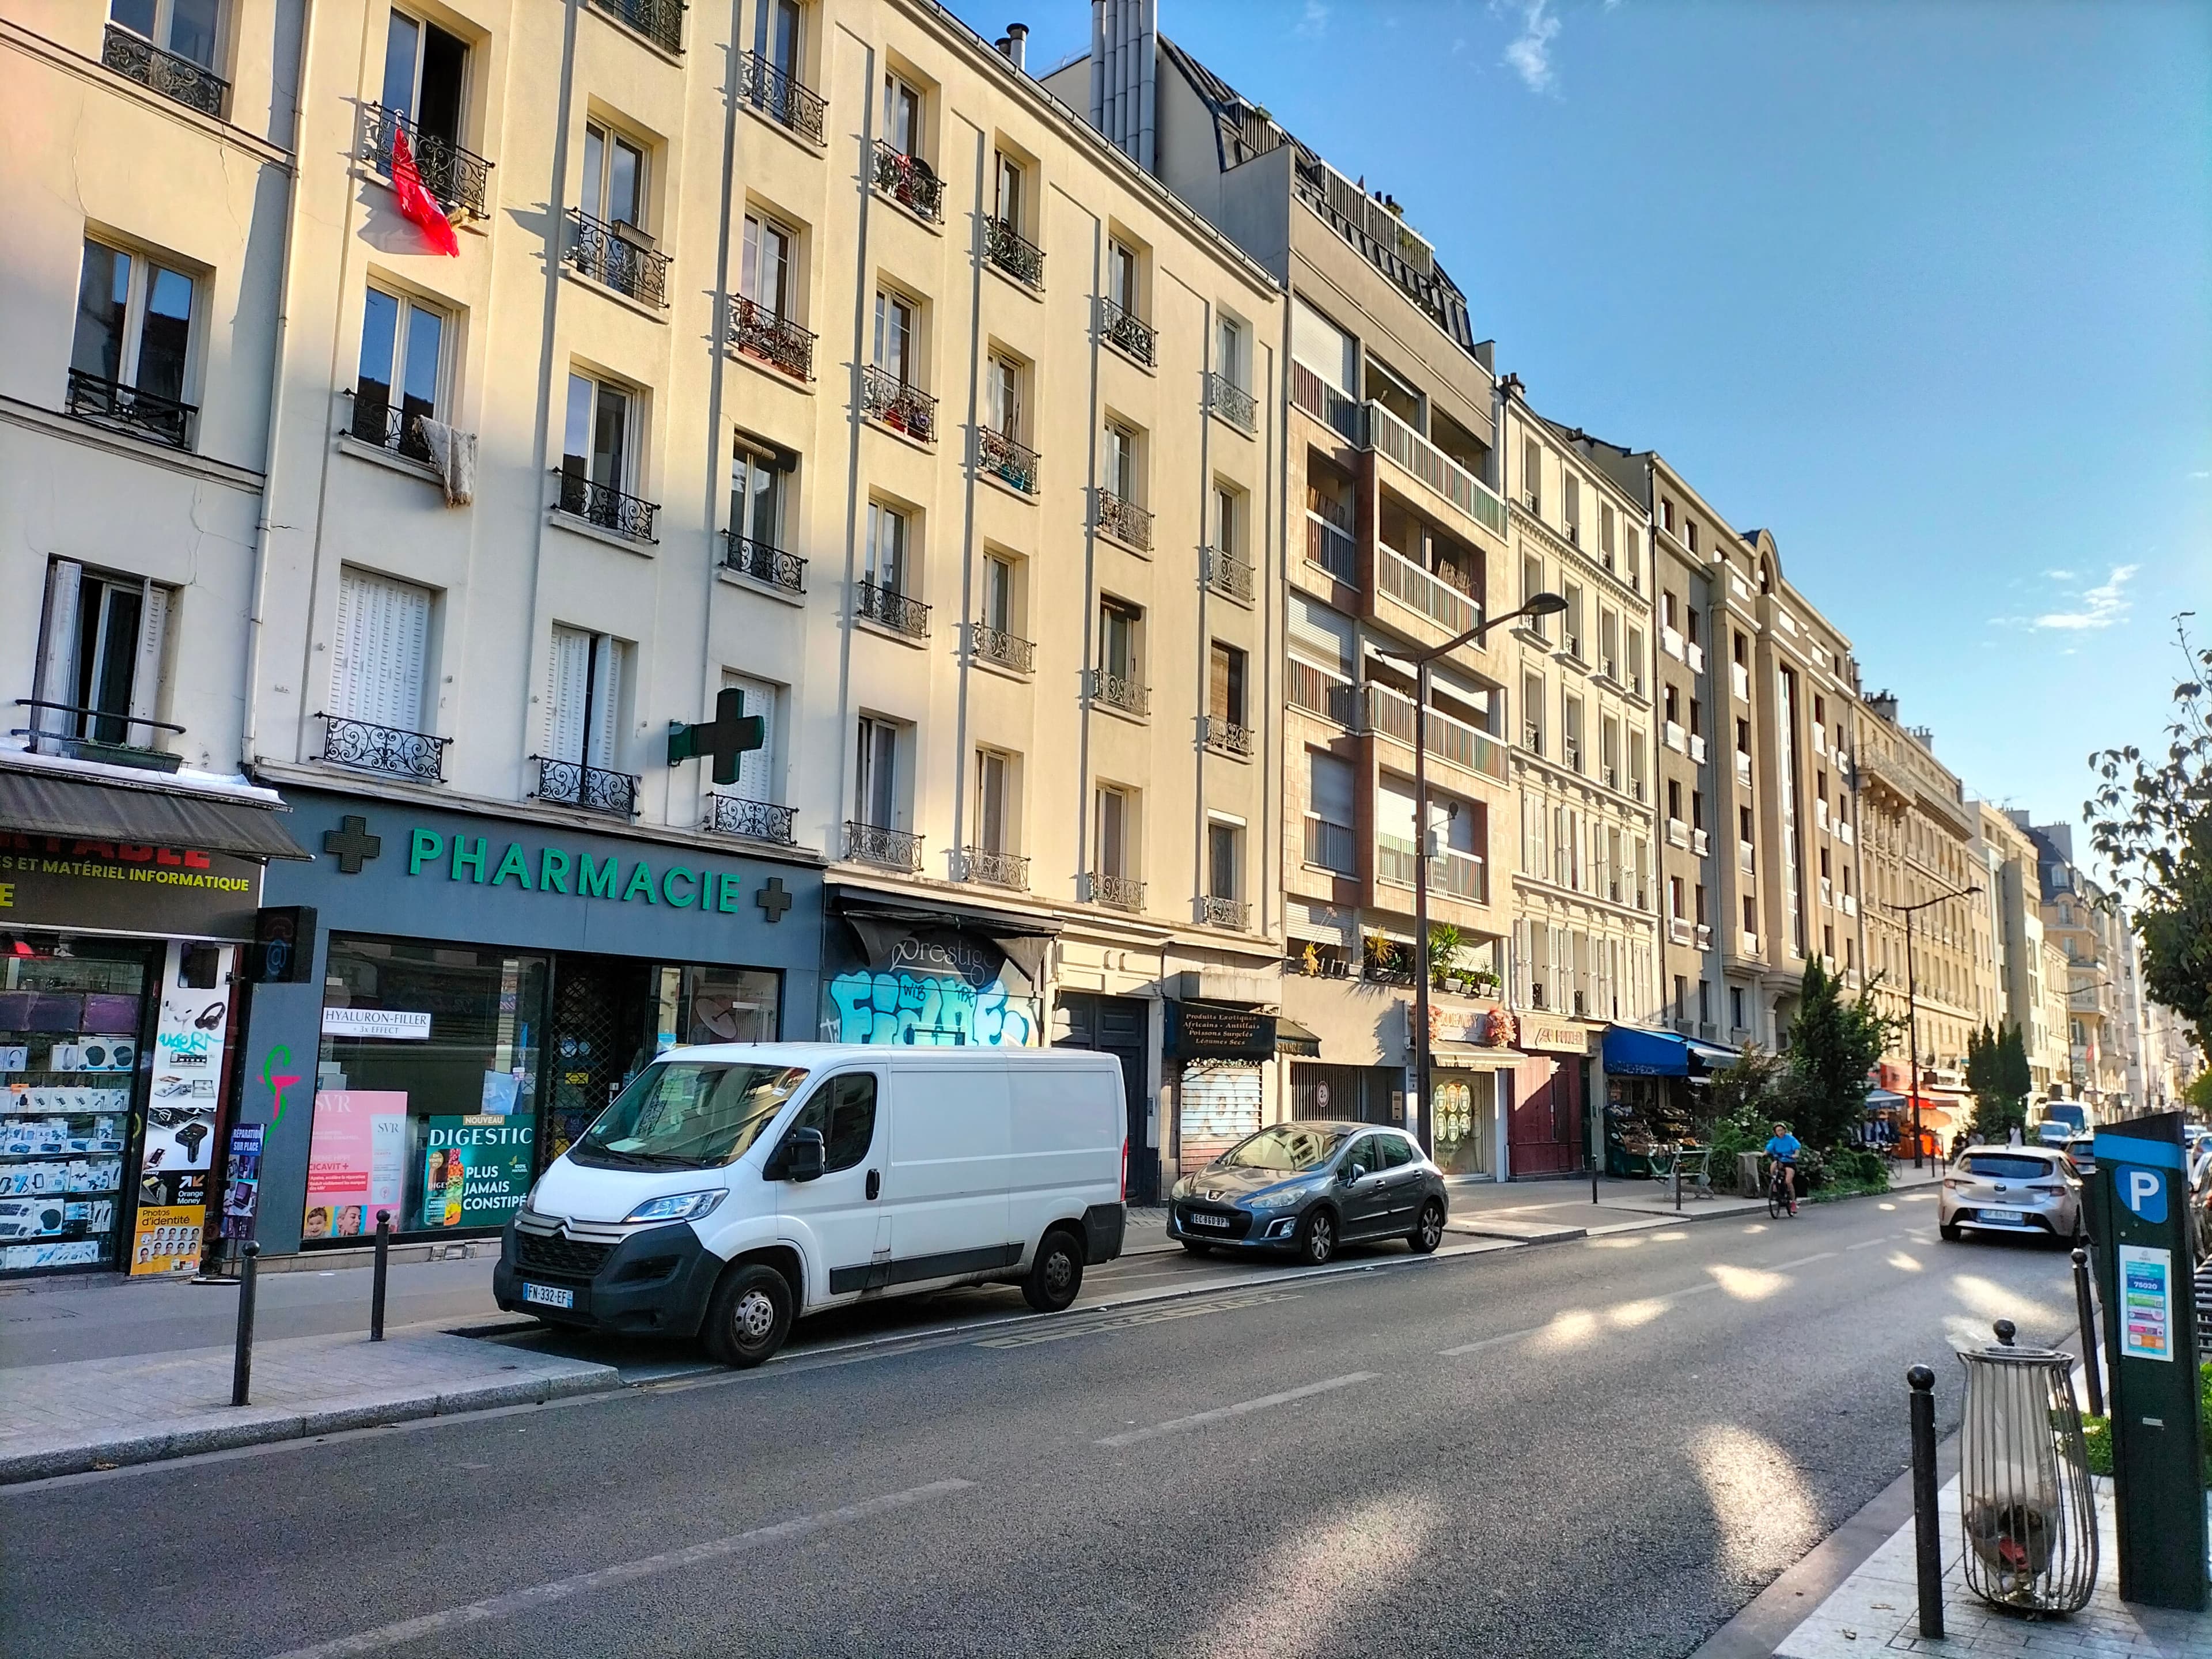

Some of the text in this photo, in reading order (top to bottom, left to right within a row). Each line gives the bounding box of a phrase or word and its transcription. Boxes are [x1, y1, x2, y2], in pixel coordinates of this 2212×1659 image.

[18, 857, 39, 871] ET
[43, 861, 125, 880] MATÉRIEL
[130, 869, 249, 892] INFORMATIQUE
[409, 827, 741, 914] PHARMACIE
[888, 935, 998, 985] Prestige
[325, 1010, 427, 1025] HYALURON-FILLER
[1277, 1041, 1302, 1053] STORE
[316, 1094, 351, 1113] SVR
[377, 1123, 399, 1133] SVR
[430, 1128, 532, 1146] DIGESTIC
[233, 1141, 259, 1151] SUR PLACE
[466, 1165, 498, 1179] PLUS
[463, 1181, 509, 1196] JAMAIS
[2130, 1172, 2159, 1211] P
[463, 1193, 527, 1210] CONSTIPÉ
[142, 1215, 190, 1226] d'identité
[2134, 1282, 2157, 1290] 75020
[528, 1286, 567, 1304] FN-332-EF
